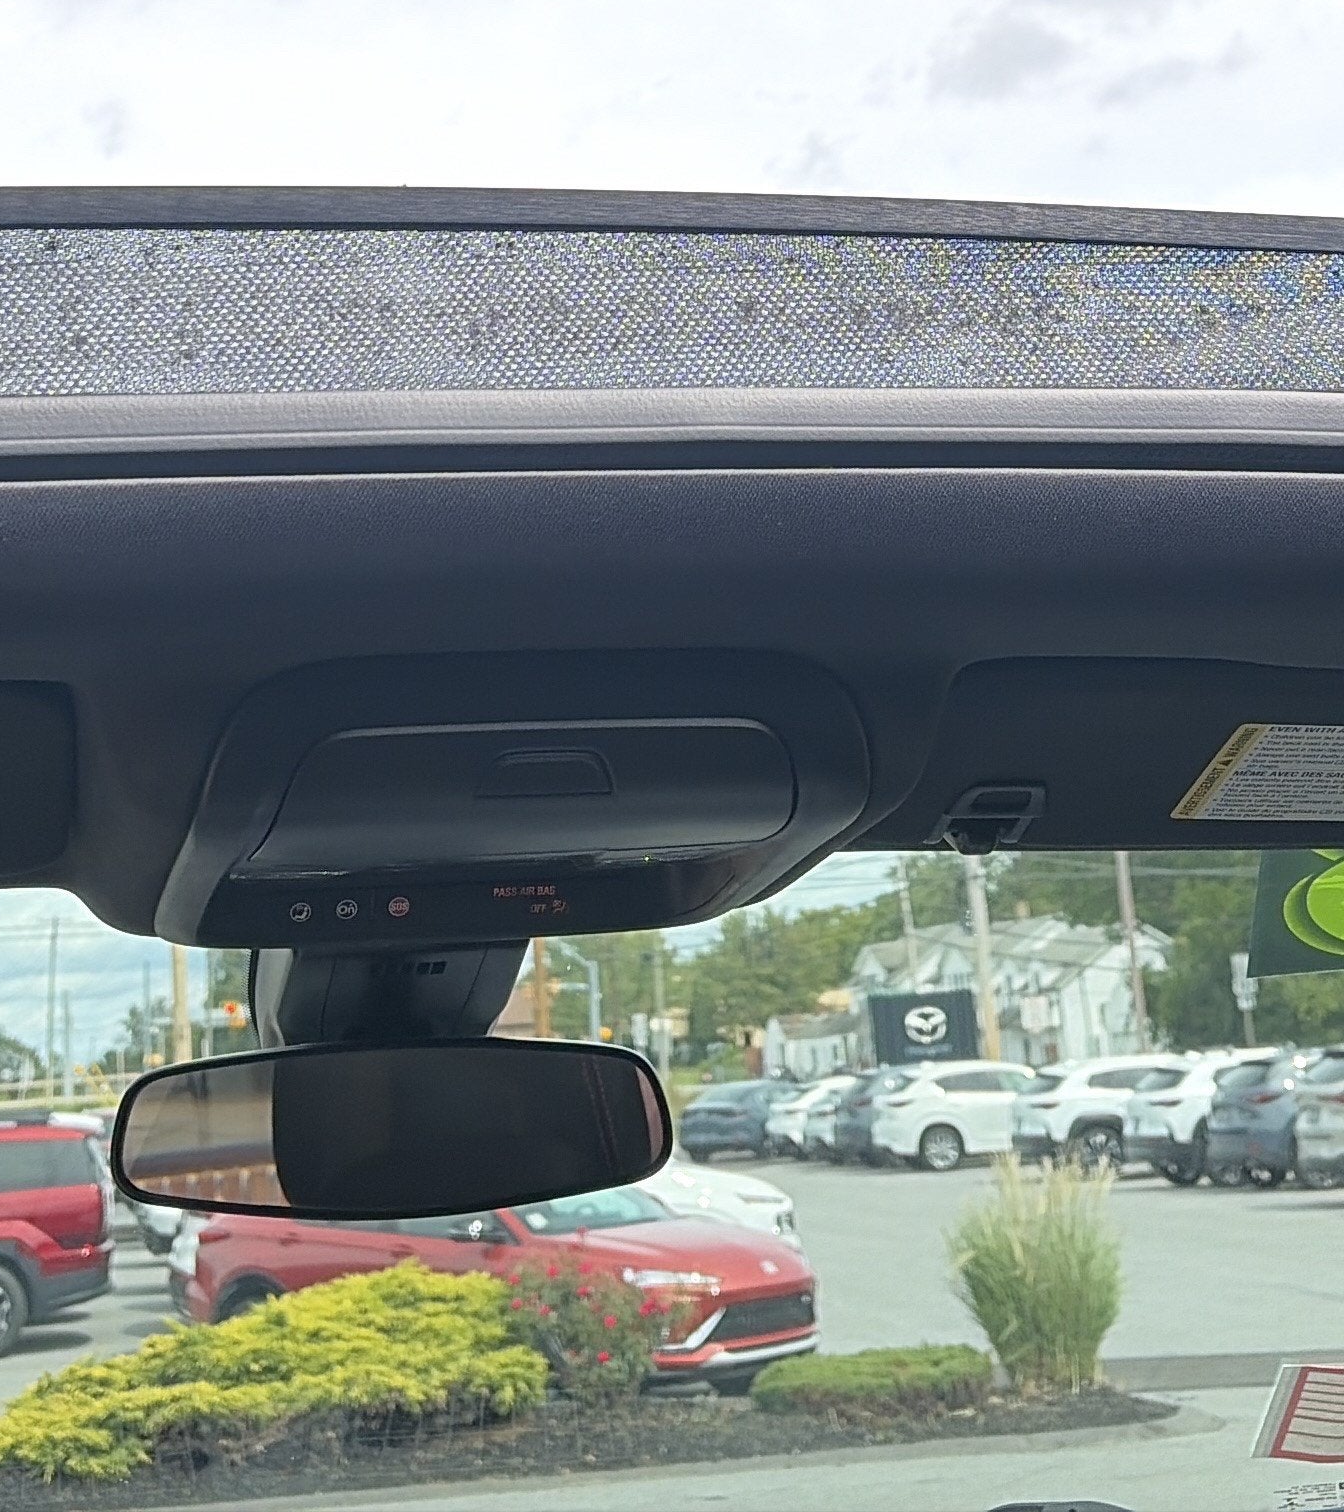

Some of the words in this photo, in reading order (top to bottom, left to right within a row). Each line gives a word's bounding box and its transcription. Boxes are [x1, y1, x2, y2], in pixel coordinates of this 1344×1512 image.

[1305, 726, 1338, 734] WITH
[1233, 769, 1267, 777] MÊME
[493, 887, 516, 897] PASS
[519, 886, 535, 896] AIR
[537, 885, 556, 896] BAG
[390, 901, 410, 912] SOS
[531, 904, 547, 913] OFF
